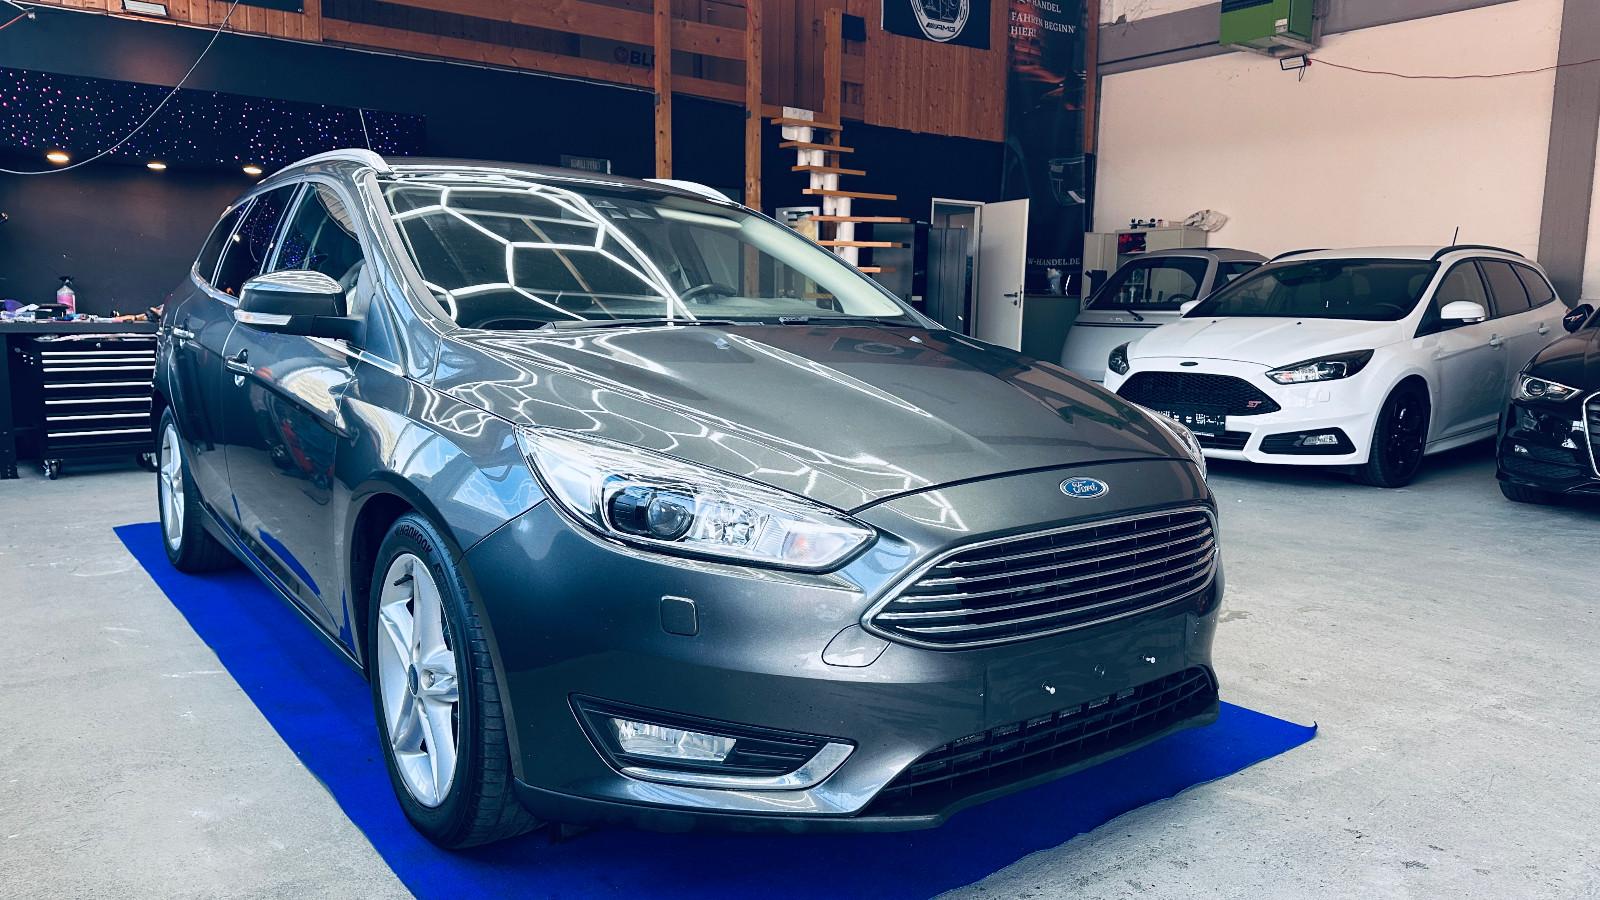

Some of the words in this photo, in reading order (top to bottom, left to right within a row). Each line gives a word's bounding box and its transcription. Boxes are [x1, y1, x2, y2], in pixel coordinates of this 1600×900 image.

[1011, 11, 1043, 27] FAHREN
[935, 24, 956, 33] AMG
[1071, 480, 1098, 494] Ford
